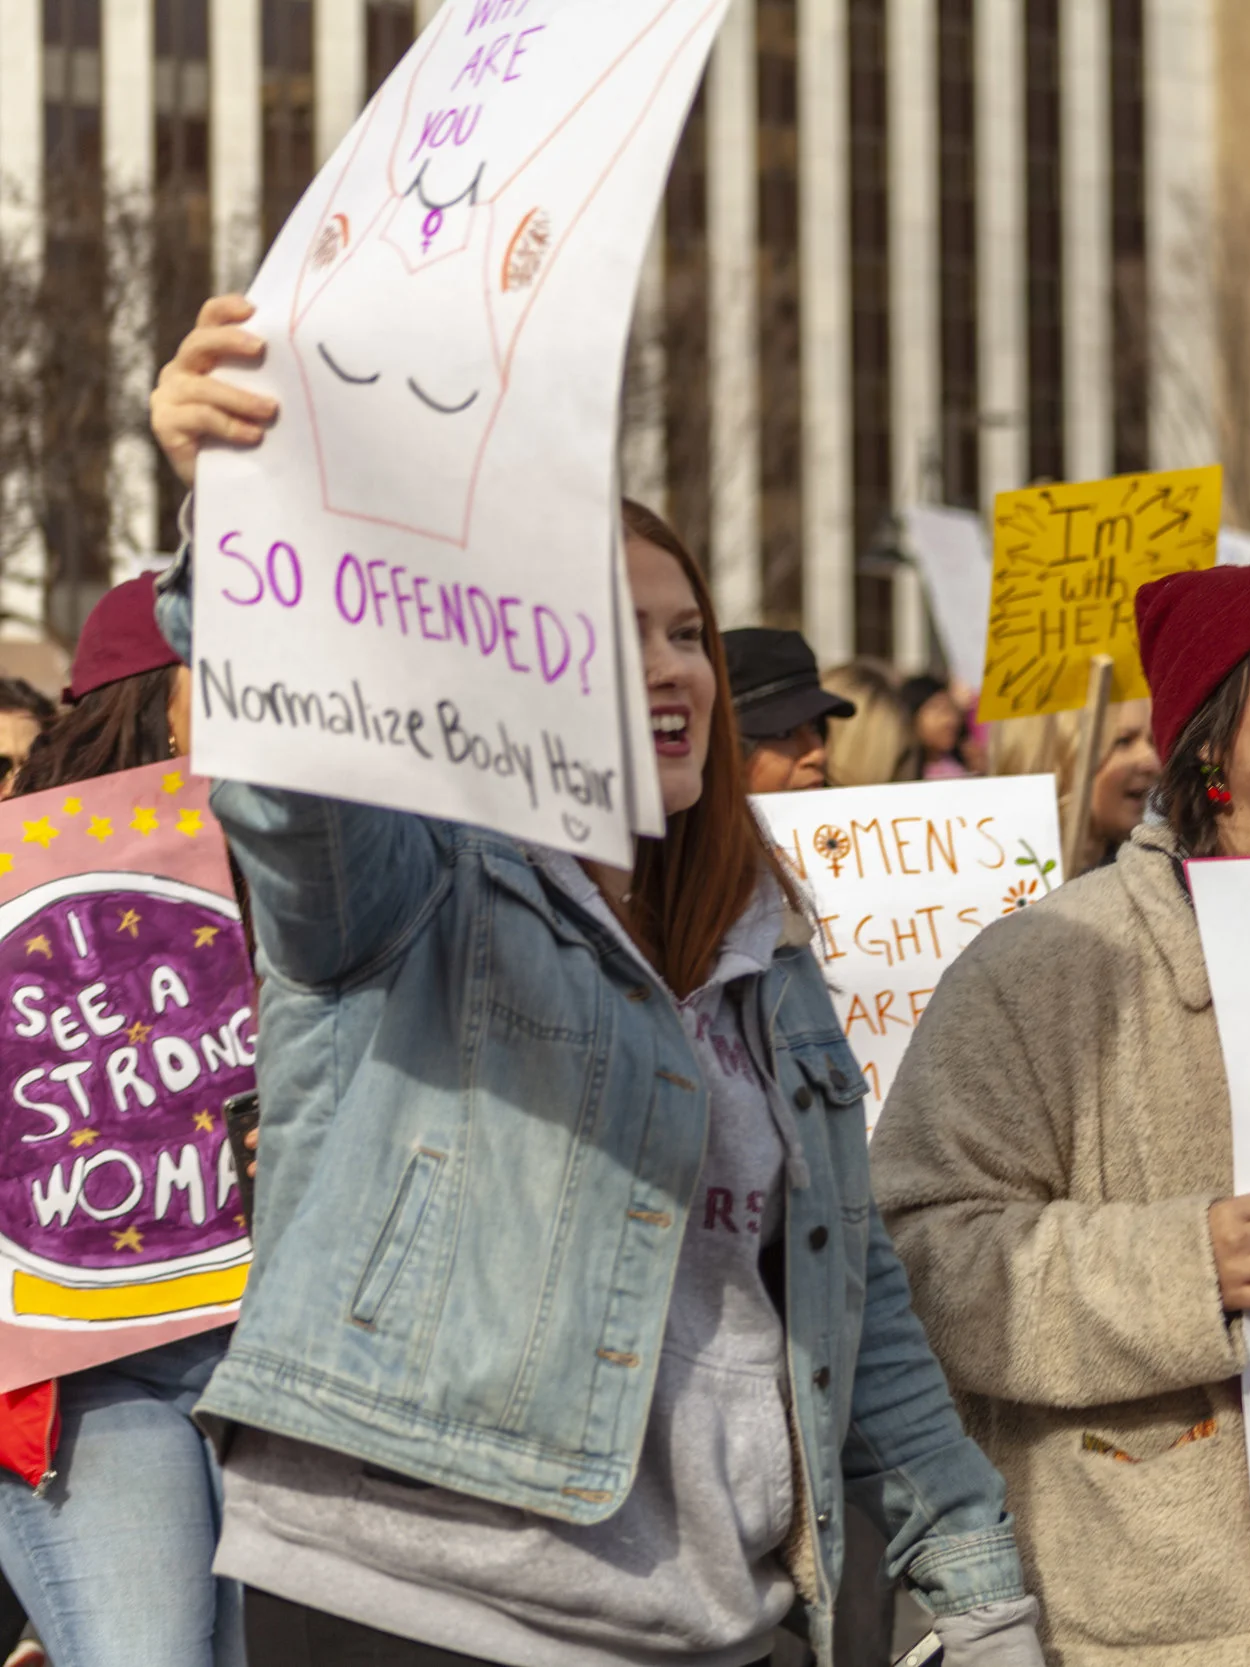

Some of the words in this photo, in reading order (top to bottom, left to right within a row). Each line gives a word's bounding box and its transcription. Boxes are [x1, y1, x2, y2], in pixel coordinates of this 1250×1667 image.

[450, 24, 548, 92] ARE
[410, 103, 483, 162] YOU
[218, 530, 303, 609] SO
[334, 552, 598, 696] OFFENDED?
[1059, 555, 1129, 603] with
[197, 657, 434, 761] Normalize
[437, 698, 540, 811] Body
[542, 730, 619, 814] Hair
[67, 909, 89, 960] I
[817, 904, 984, 967] IGHTS
[13, 984, 125, 1052] SEE
[149, 963, 191, 1014] A
[843, 986, 937, 1036] ARE
[12, 1006, 258, 1144] STRONG
[32, 1138, 239, 1228] WOMA
